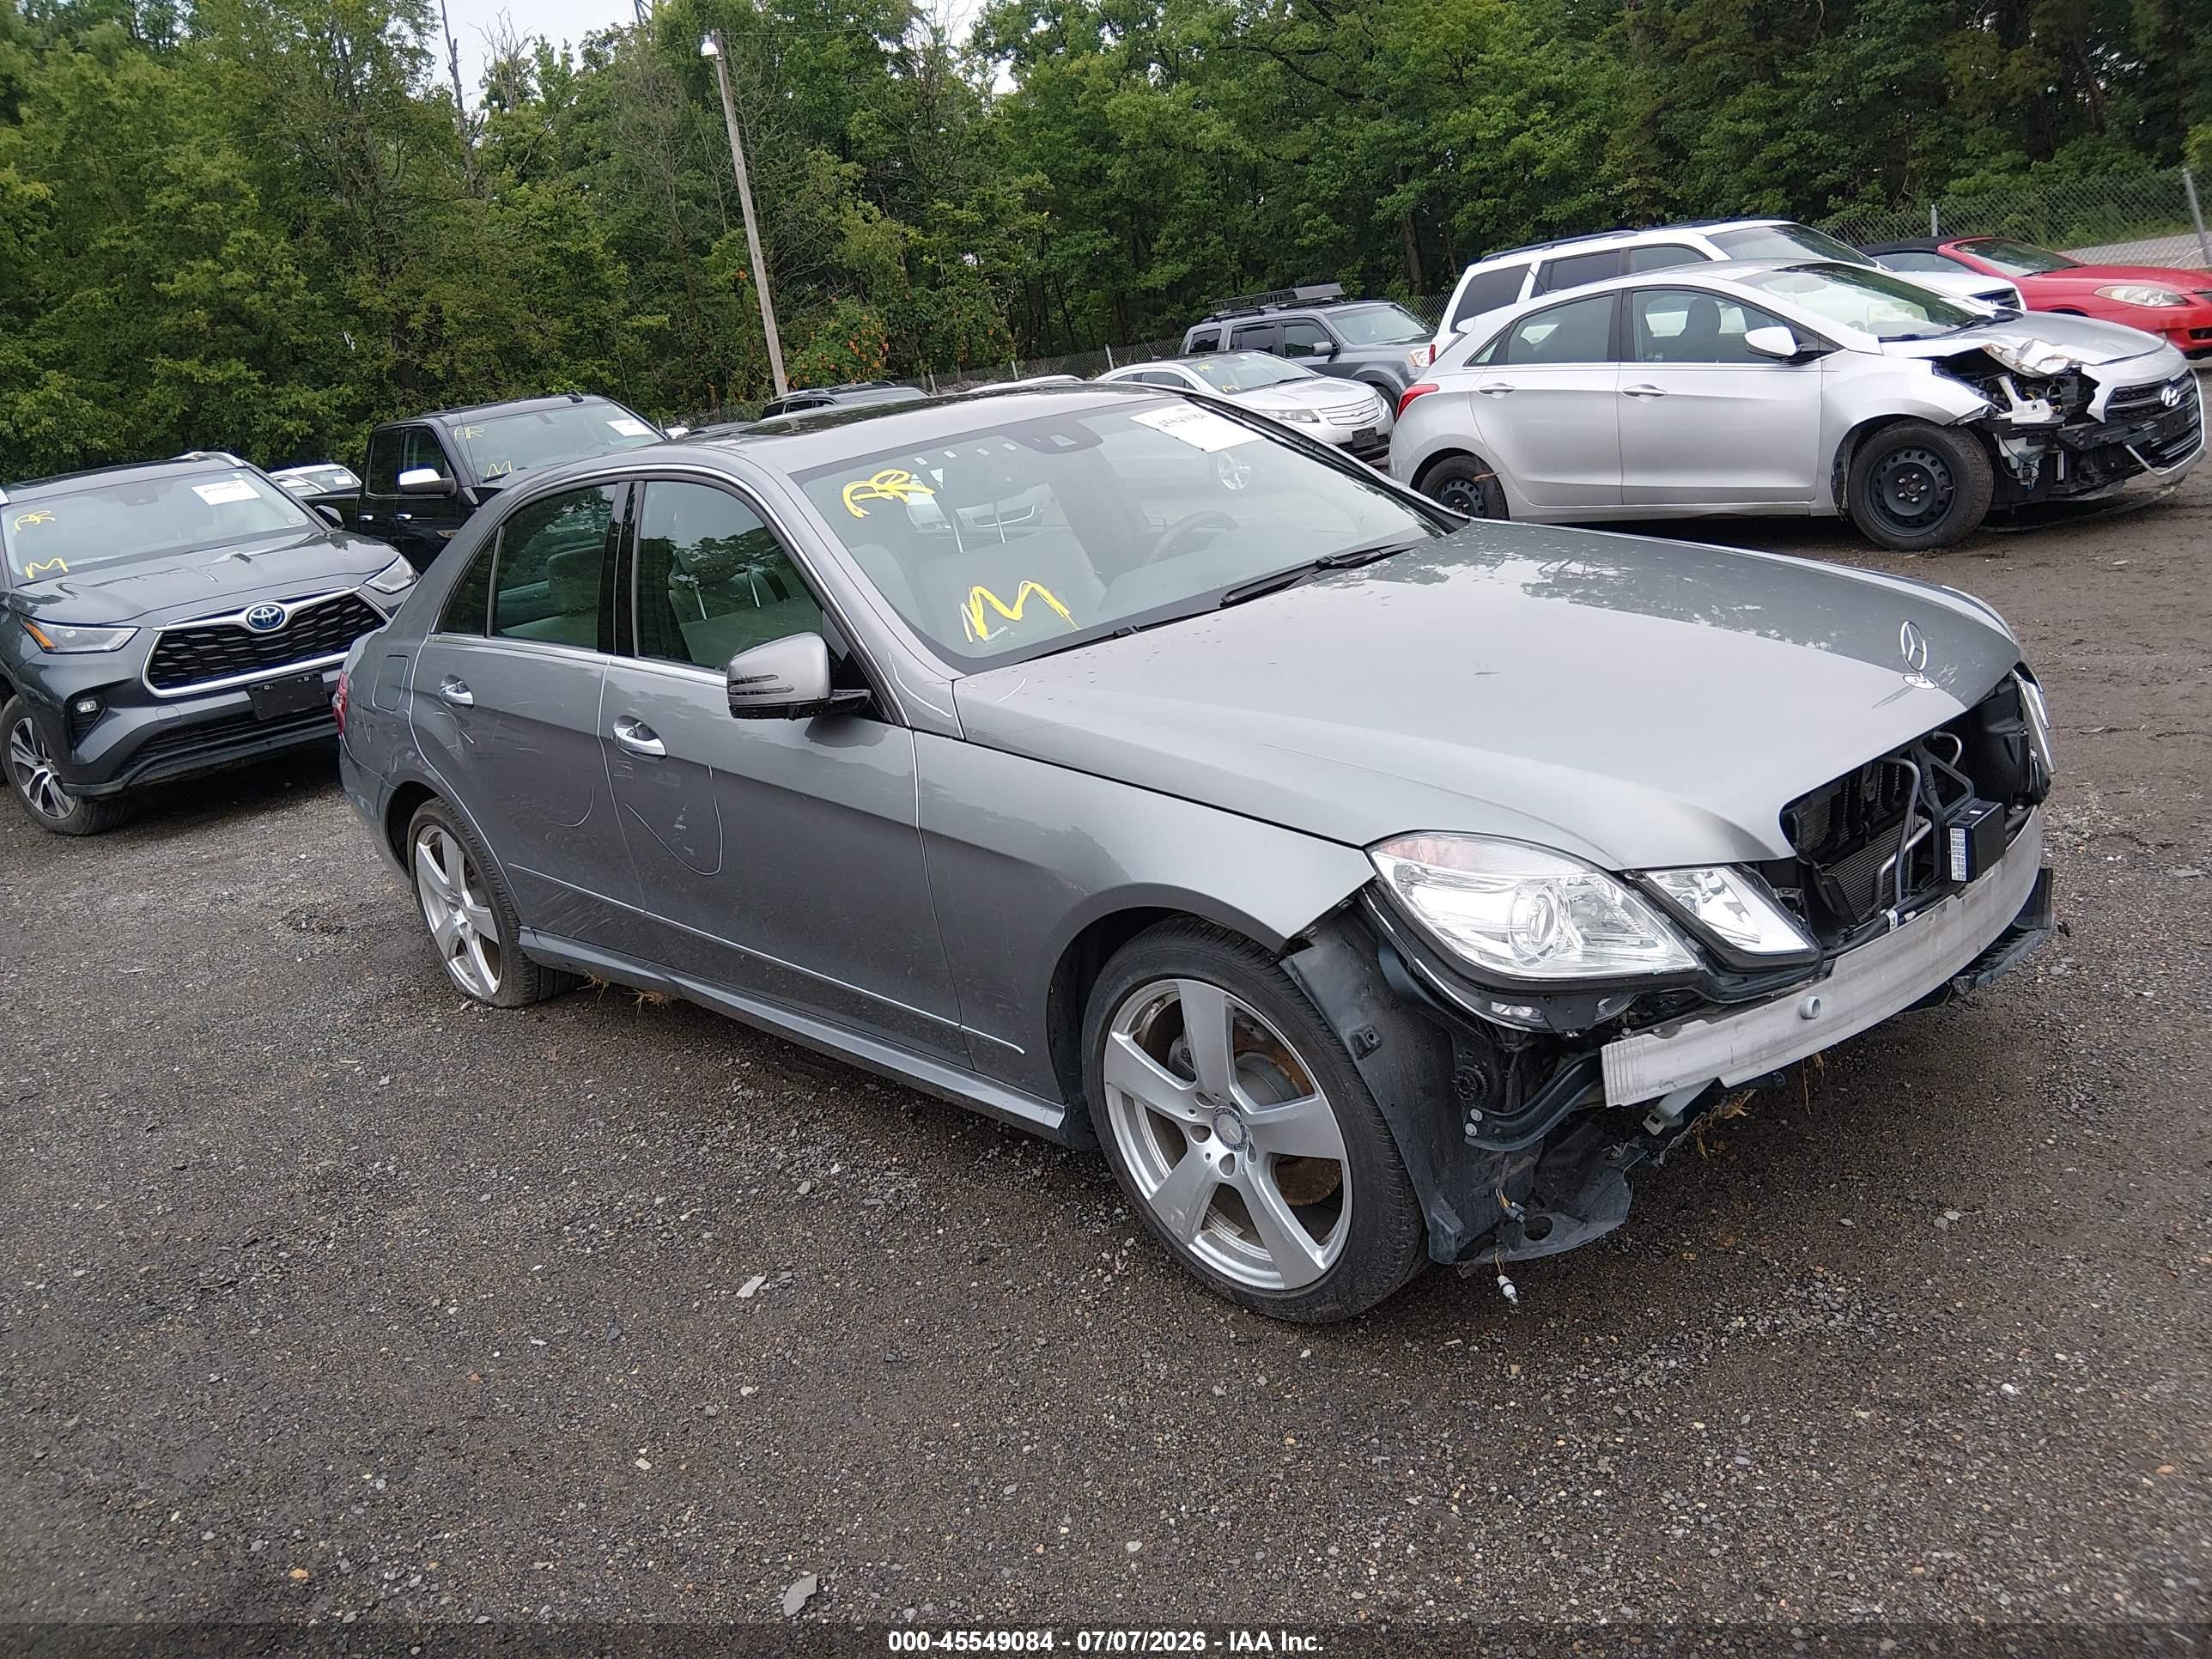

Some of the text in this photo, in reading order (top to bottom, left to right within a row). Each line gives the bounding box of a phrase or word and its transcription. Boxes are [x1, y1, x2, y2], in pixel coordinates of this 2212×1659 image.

[453, 426, 486, 441] AR
[25, 556, 70, 579] M
[961, 580, 1080, 644] M
